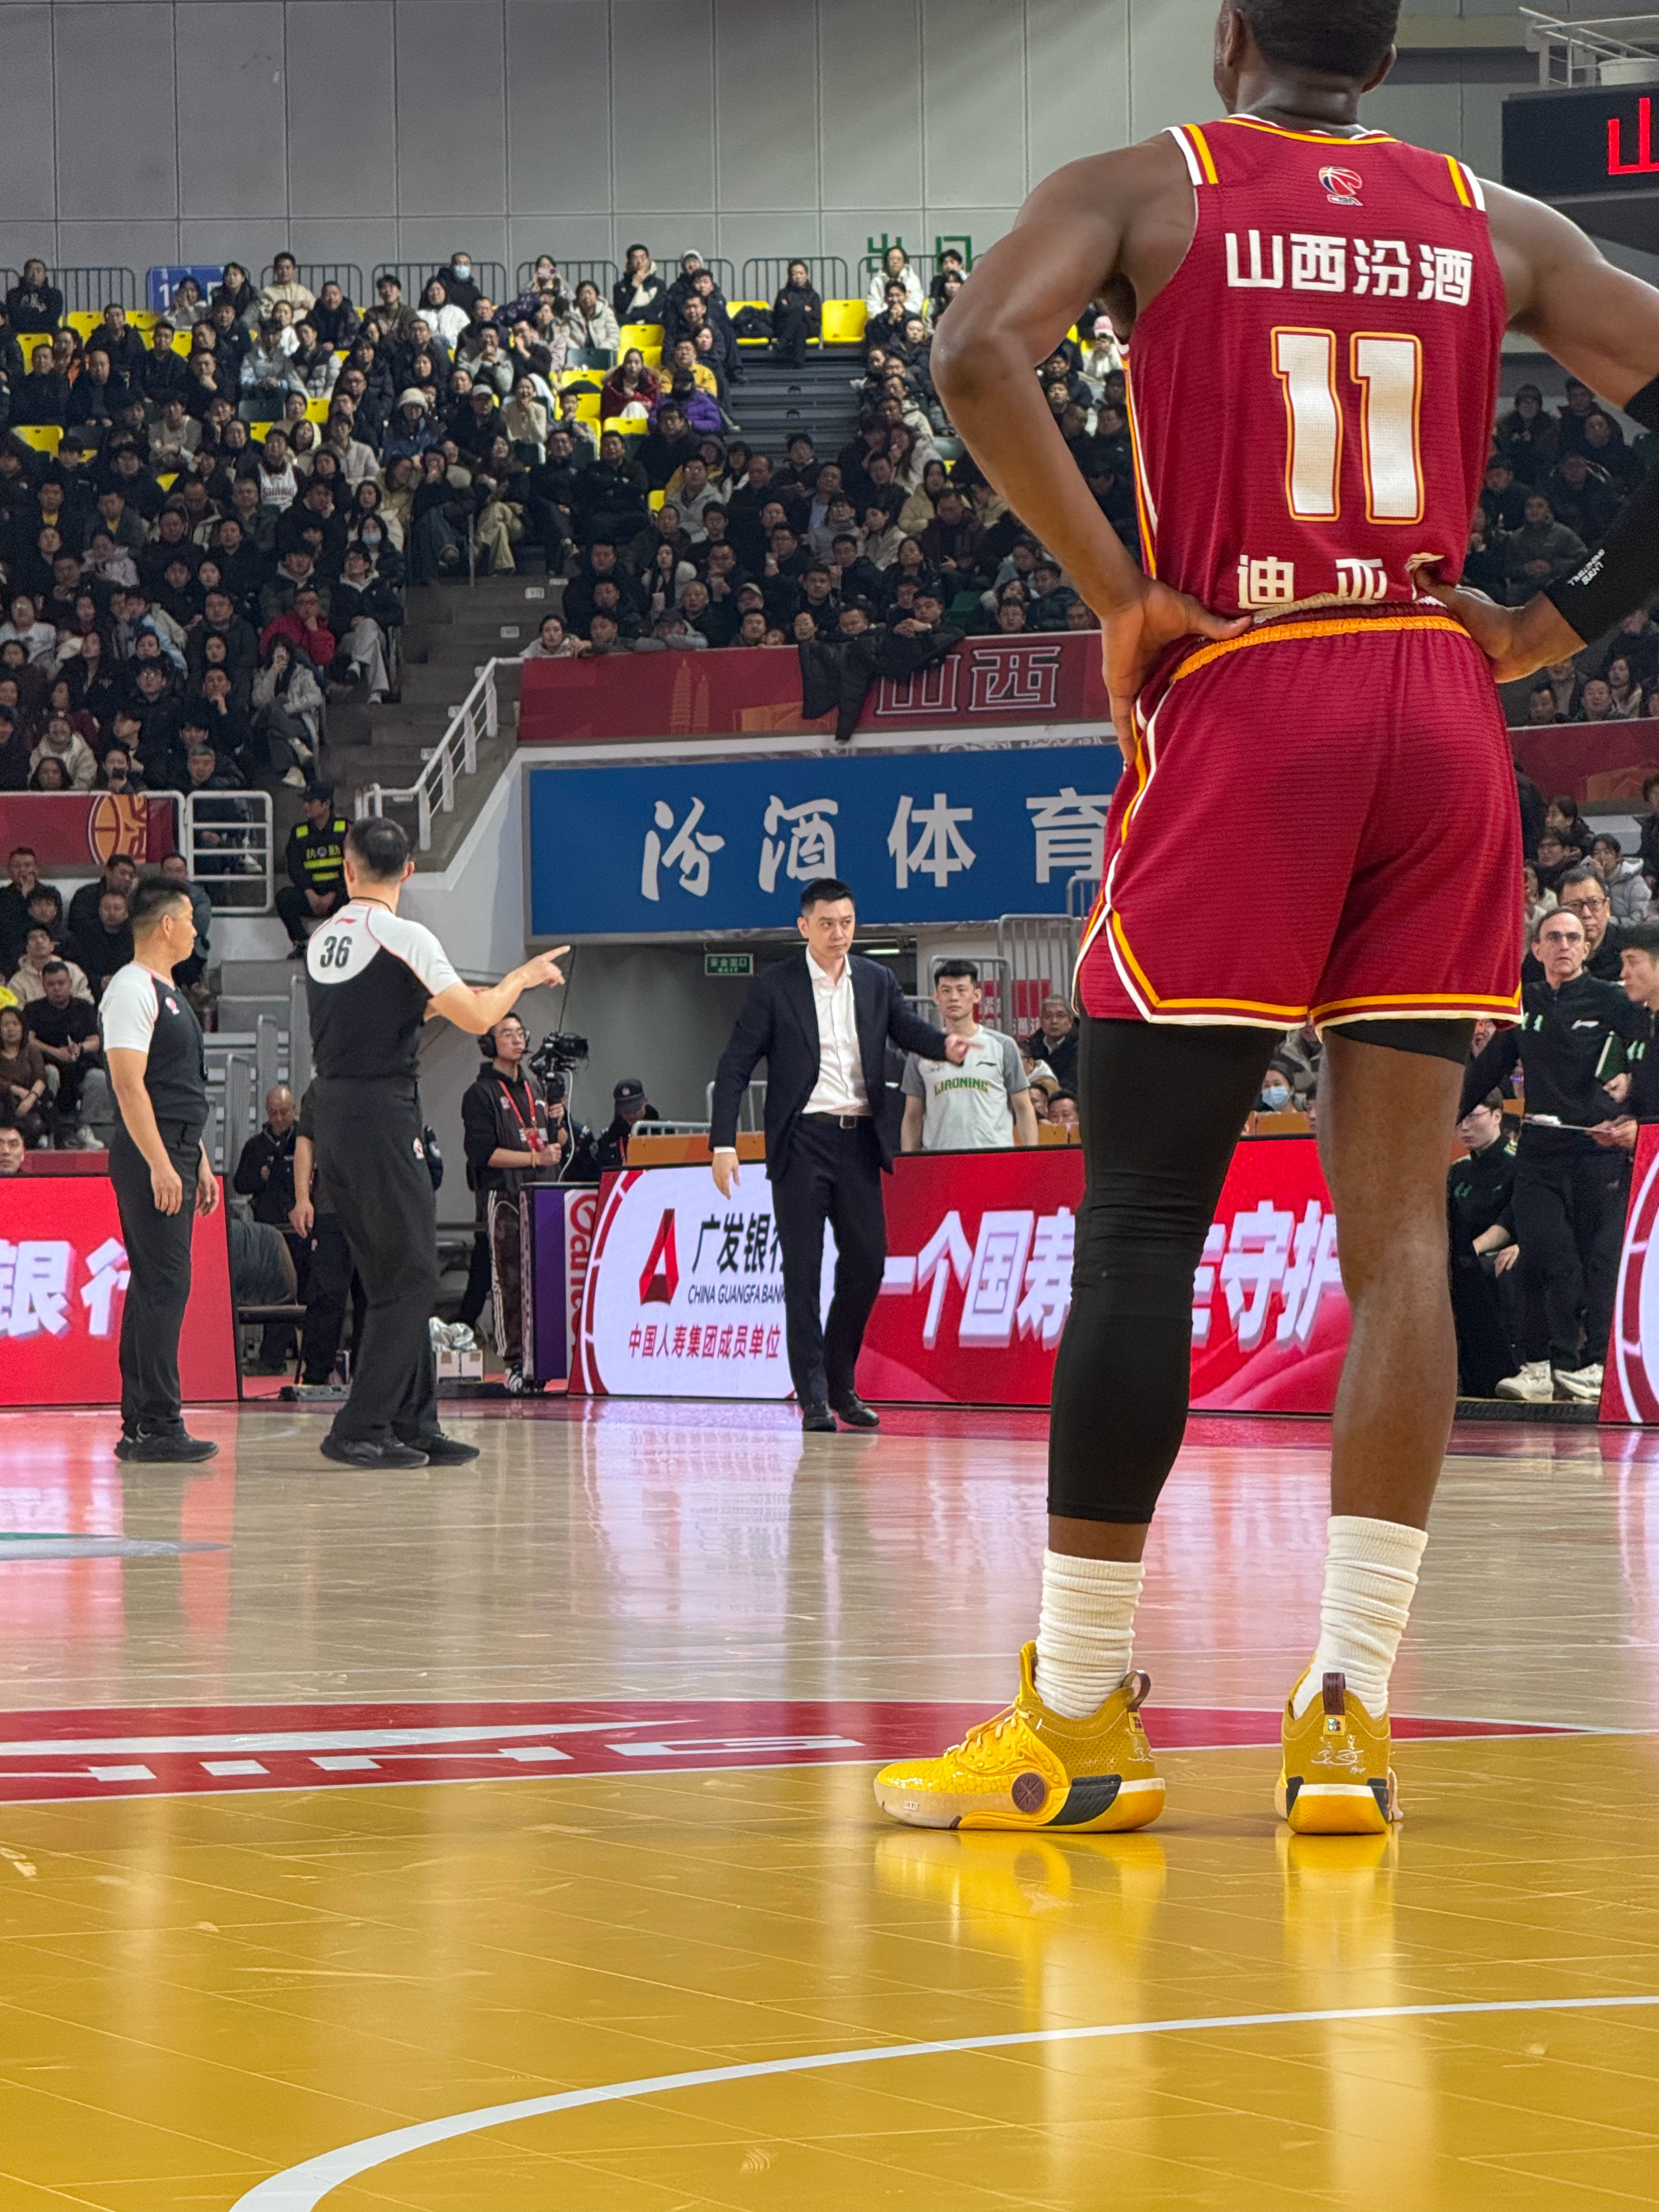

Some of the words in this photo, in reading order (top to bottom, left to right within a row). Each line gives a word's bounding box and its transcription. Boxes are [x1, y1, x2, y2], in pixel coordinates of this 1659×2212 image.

[1224, 229, 1474, 307] 山西汾酒
[1271, 326, 1425, 525] 11
[876, 646, 1062, 715] 山西
[641, 787, 1109, 901] 汾酒体育
[320, 935, 353, 968] 36
[934, 1076, 990, 1097] LIAONING
[688, 1284, 715, 1304] CHINA
[717, 1284, 760, 1305] GUANGFA
[879, 1206, 1076, 1352] 一个国寿
[628, 1323, 781, 1359] 中国人寿集团成员单位
